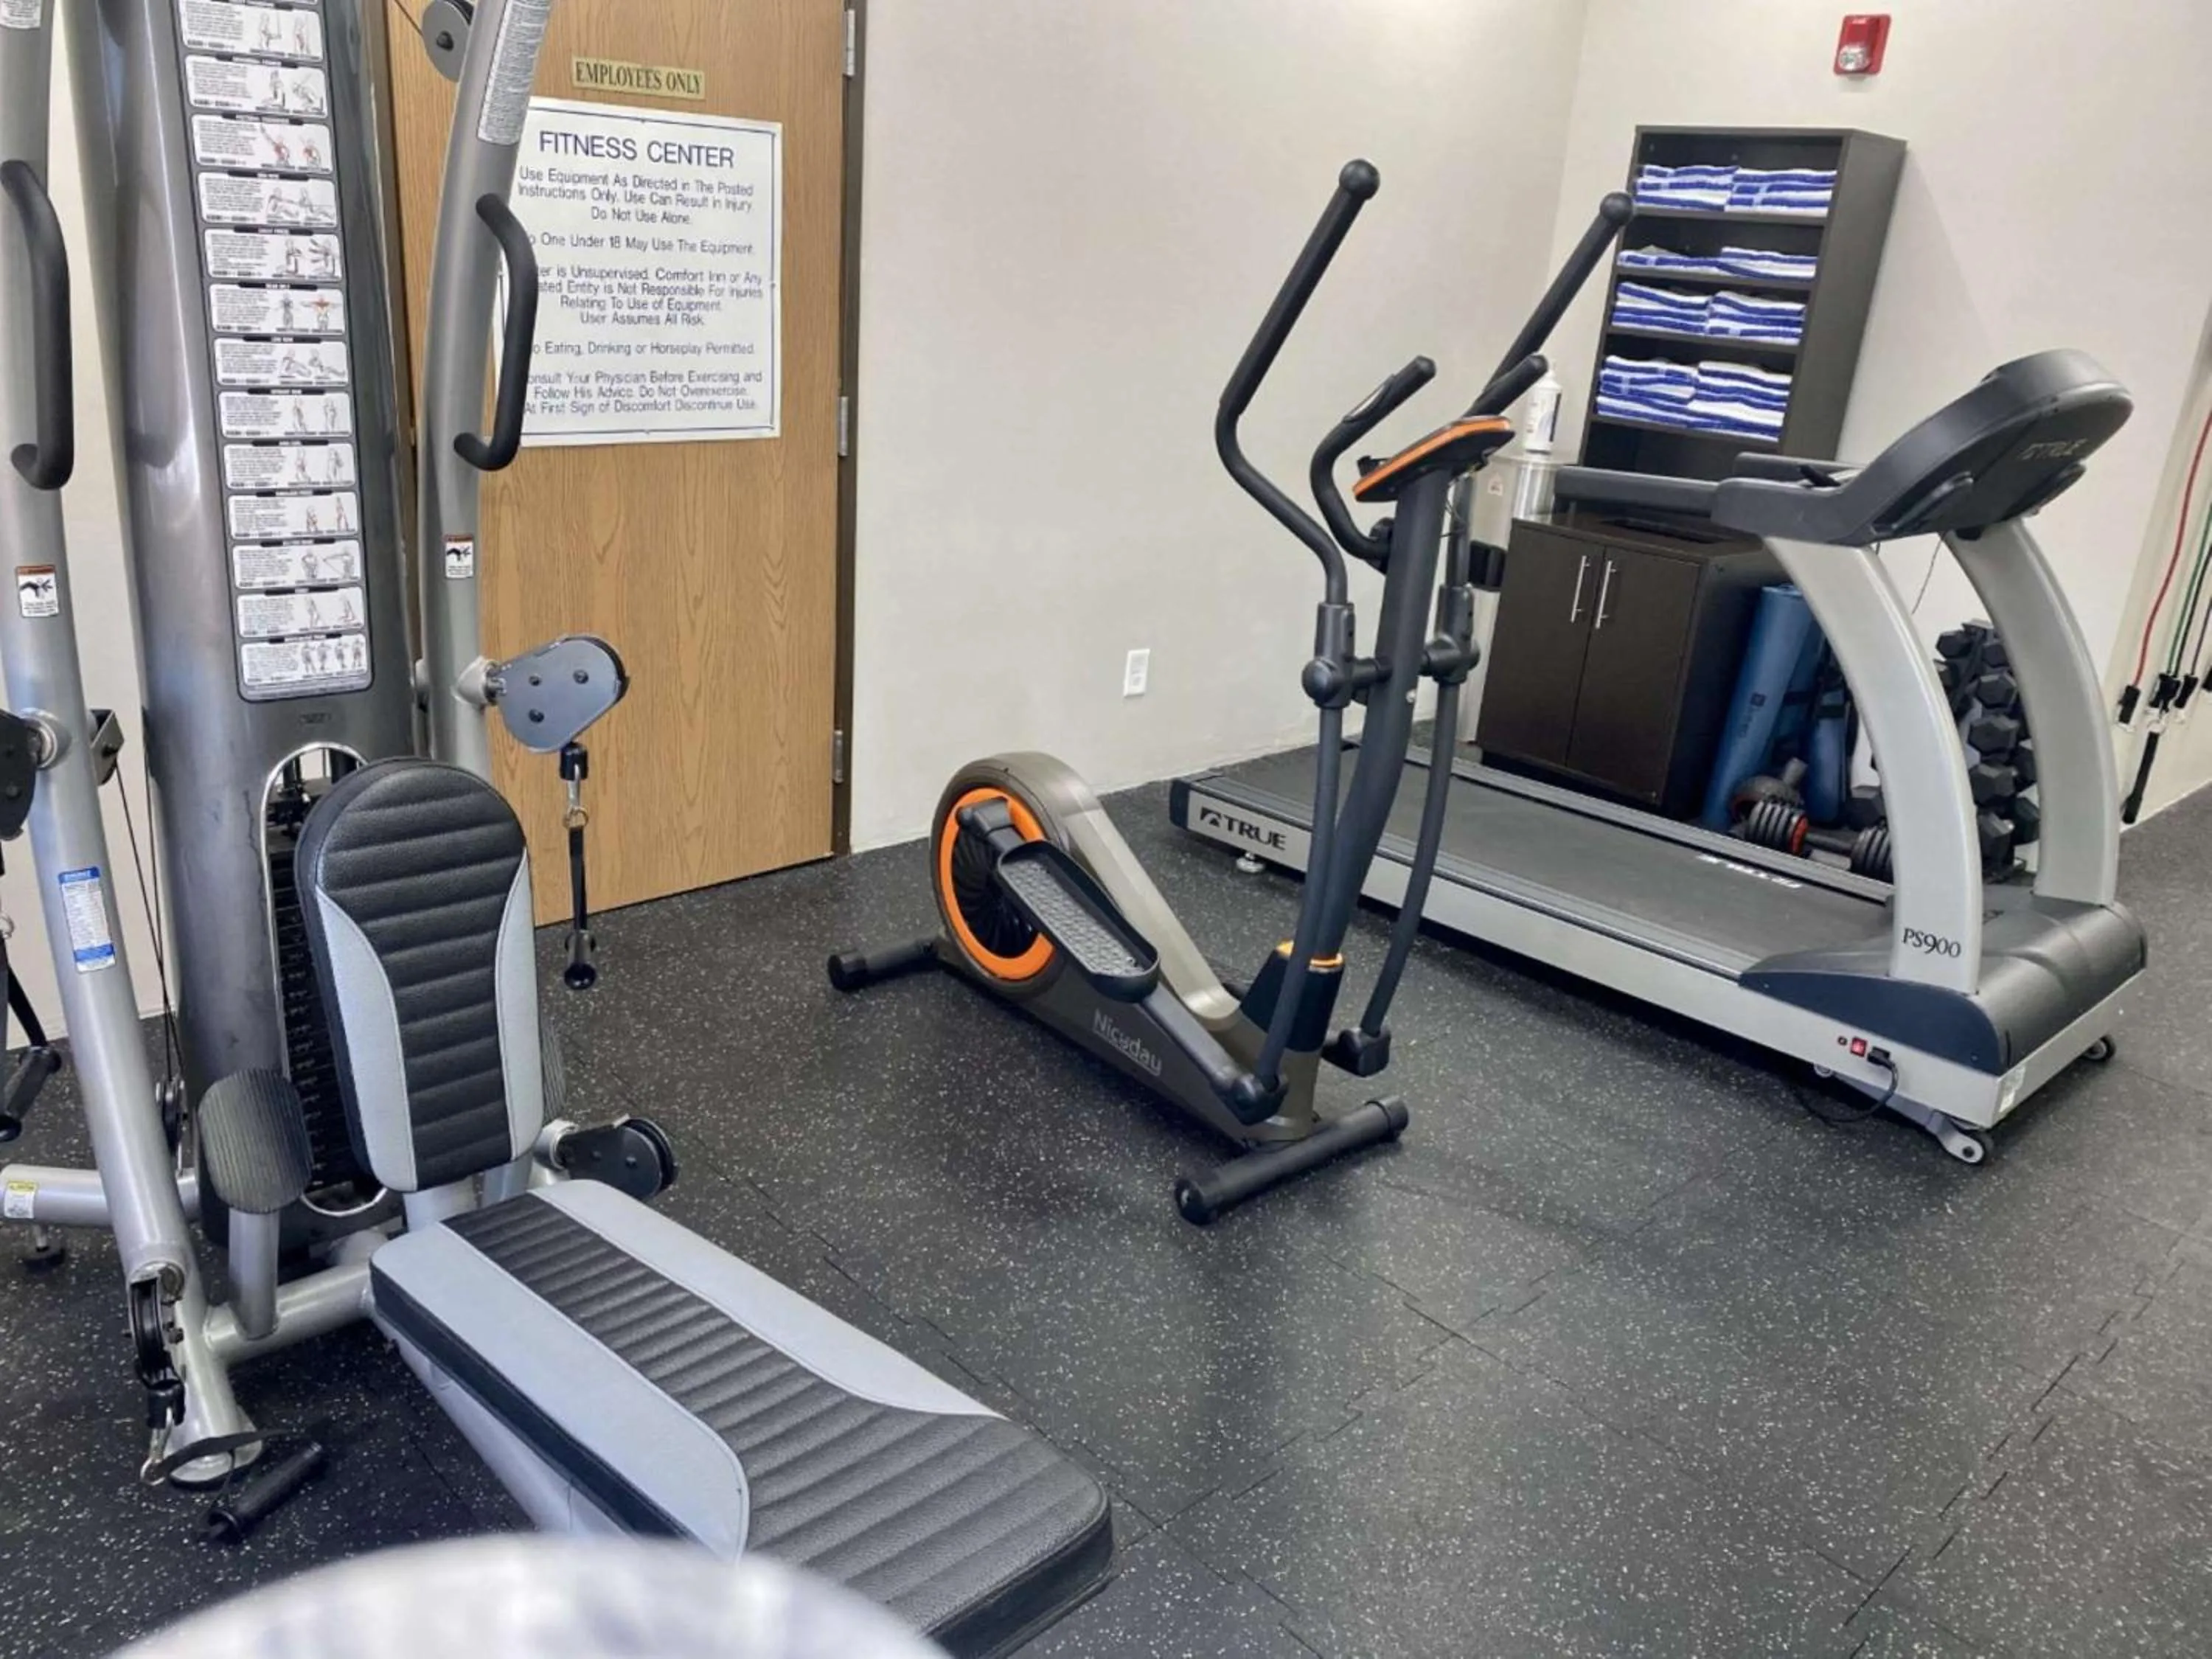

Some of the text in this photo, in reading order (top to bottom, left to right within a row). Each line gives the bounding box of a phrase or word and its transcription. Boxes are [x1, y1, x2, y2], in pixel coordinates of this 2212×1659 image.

[576, 62, 702, 94] EMPLOYEES ONLY
[540, 131, 734, 169] FITNESS CENTER
[520, 166, 543, 182] Use
[548, 168, 609, 187] Equipment
[613, 174, 628, 187] As
[633, 175, 677, 192] Directed
[695, 180, 714, 194] The
[718, 181, 754, 197] Posted
[518, 182, 586, 201] Instructions
[625, 189, 646, 204] Use
[650, 192, 672, 206] Can
[676, 195, 708, 208] Result
[591, 206, 607, 220] Do
[612, 208, 631, 221] Not
[636, 209, 657, 223] Use
[541, 232, 566, 246] One
[571, 234, 605, 248] Under
[610, 235, 621, 248] 18
[626, 236, 648, 252] May
[652, 237, 674, 251] Use
[678, 239, 697, 253] The
[557, 263, 566, 277] is
[655, 267, 704, 282] Comfort
[709, 271, 726, 282] Inn
[730, 274, 740, 284] or
[744, 271, 762, 285] Any
[568, 280, 600, 295] Entity
[605, 282, 613, 294] is
[618, 282, 637, 295] Not
[641, 282, 705, 297] Responsible
[709, 285, 725, 297] For
[729, 287, 764, 299] Injuries
[560, 295, 605, 310] Relating
[611, 296, 624, 309] To
[628, 298, 649, 310] Use
[653, 299, 664, 310] of
[580, 312, 606, 324] User
[612, 312, 661, 325] Assumes
[665, 313, 677, 325] All
[588, 341, 631, 356] Drinking
[636, 344, 648, 355] or
[650, 342, 702, 357] Horseplay
[528, 370, 762, 386] onsult Your Physician Before Exercising and
[534, 386, 569, 400] Follow
[574, 386, 592, 399] His
[639, 385, 655, 398] Do
[658, 385, 676, 397] Not
[541, 400, 566, 414] First
[571, 400, 595, 417] Sign
[599, 400, 610, 413] of
[614, 400, 670, 414] Discomfort
[675, 399, 732, 412] Discontinue
[1222, 814, 1287, 852] TRUE
[1902, 928, 1962, 959] PS900
